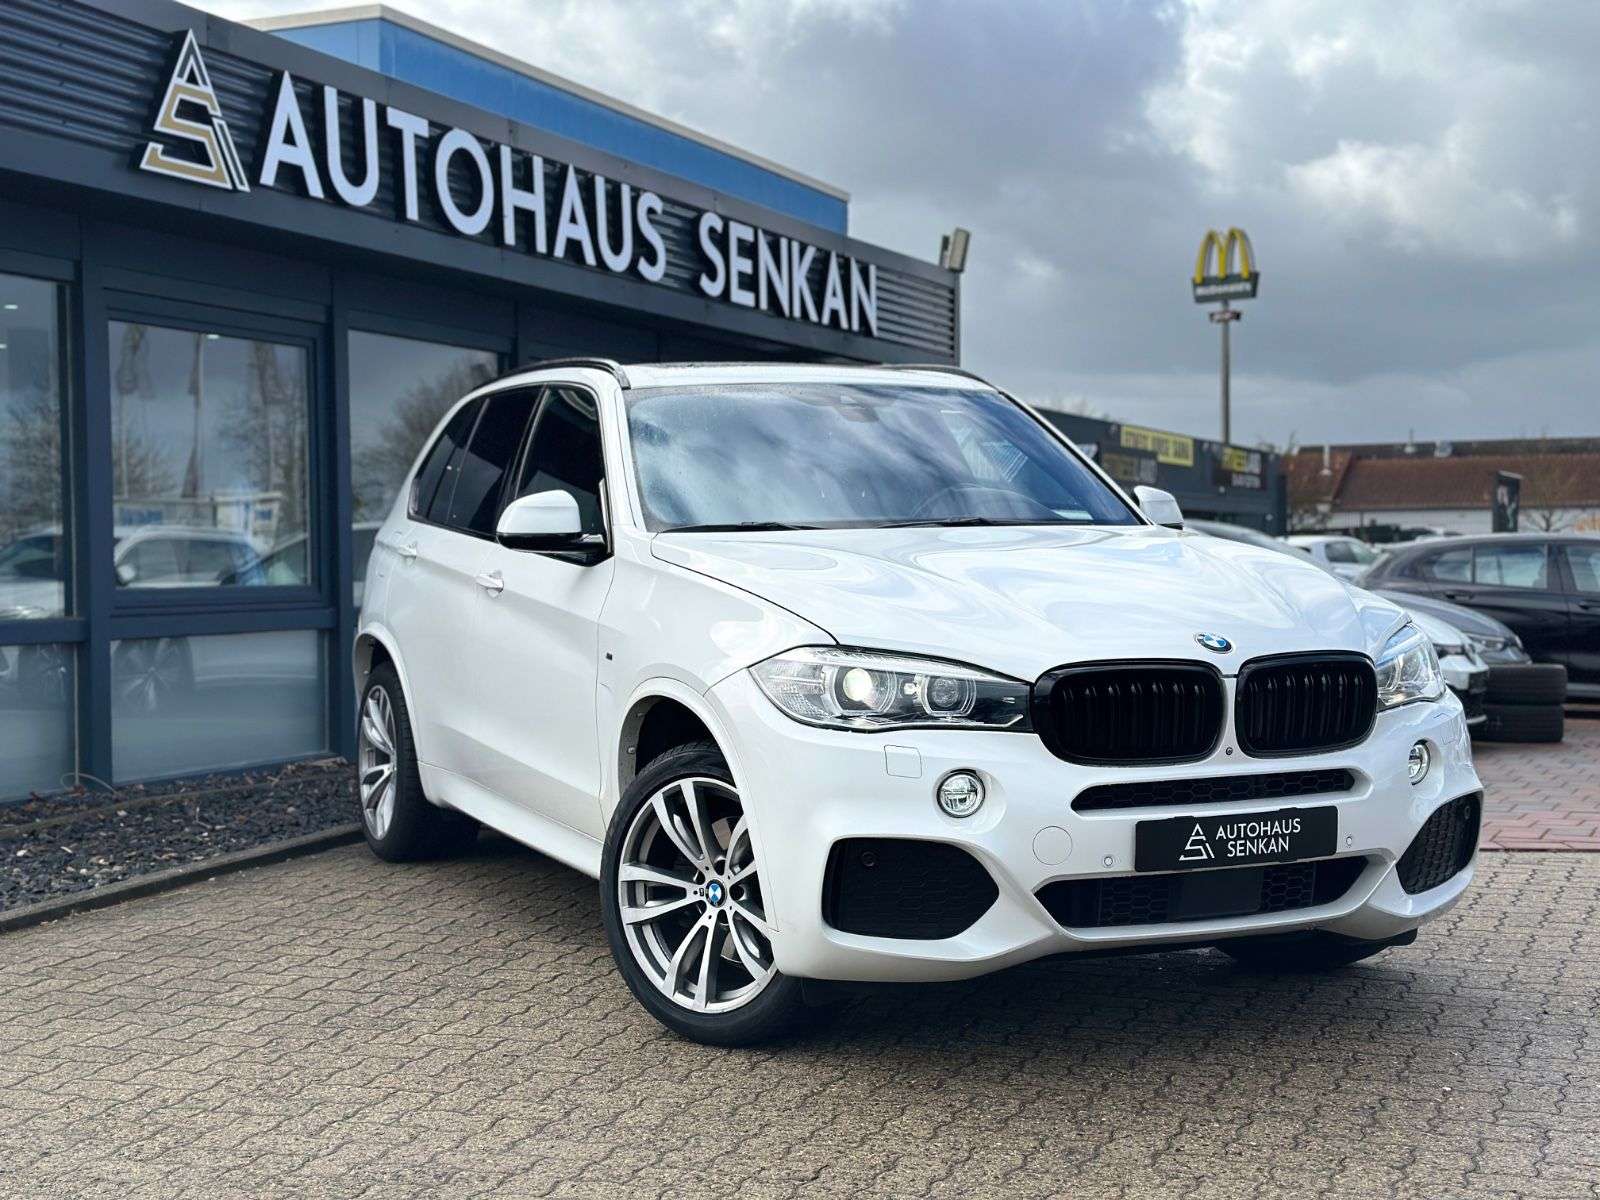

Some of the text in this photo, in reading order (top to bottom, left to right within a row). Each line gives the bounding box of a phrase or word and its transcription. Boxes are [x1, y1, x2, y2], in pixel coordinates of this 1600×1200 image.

[259, 70, 878, 336] AUTOHAUS SENKAN
[1215, 818, 1301, 840] AUTOHAUS
[1227, 836, 1289, 857] SENKAN
